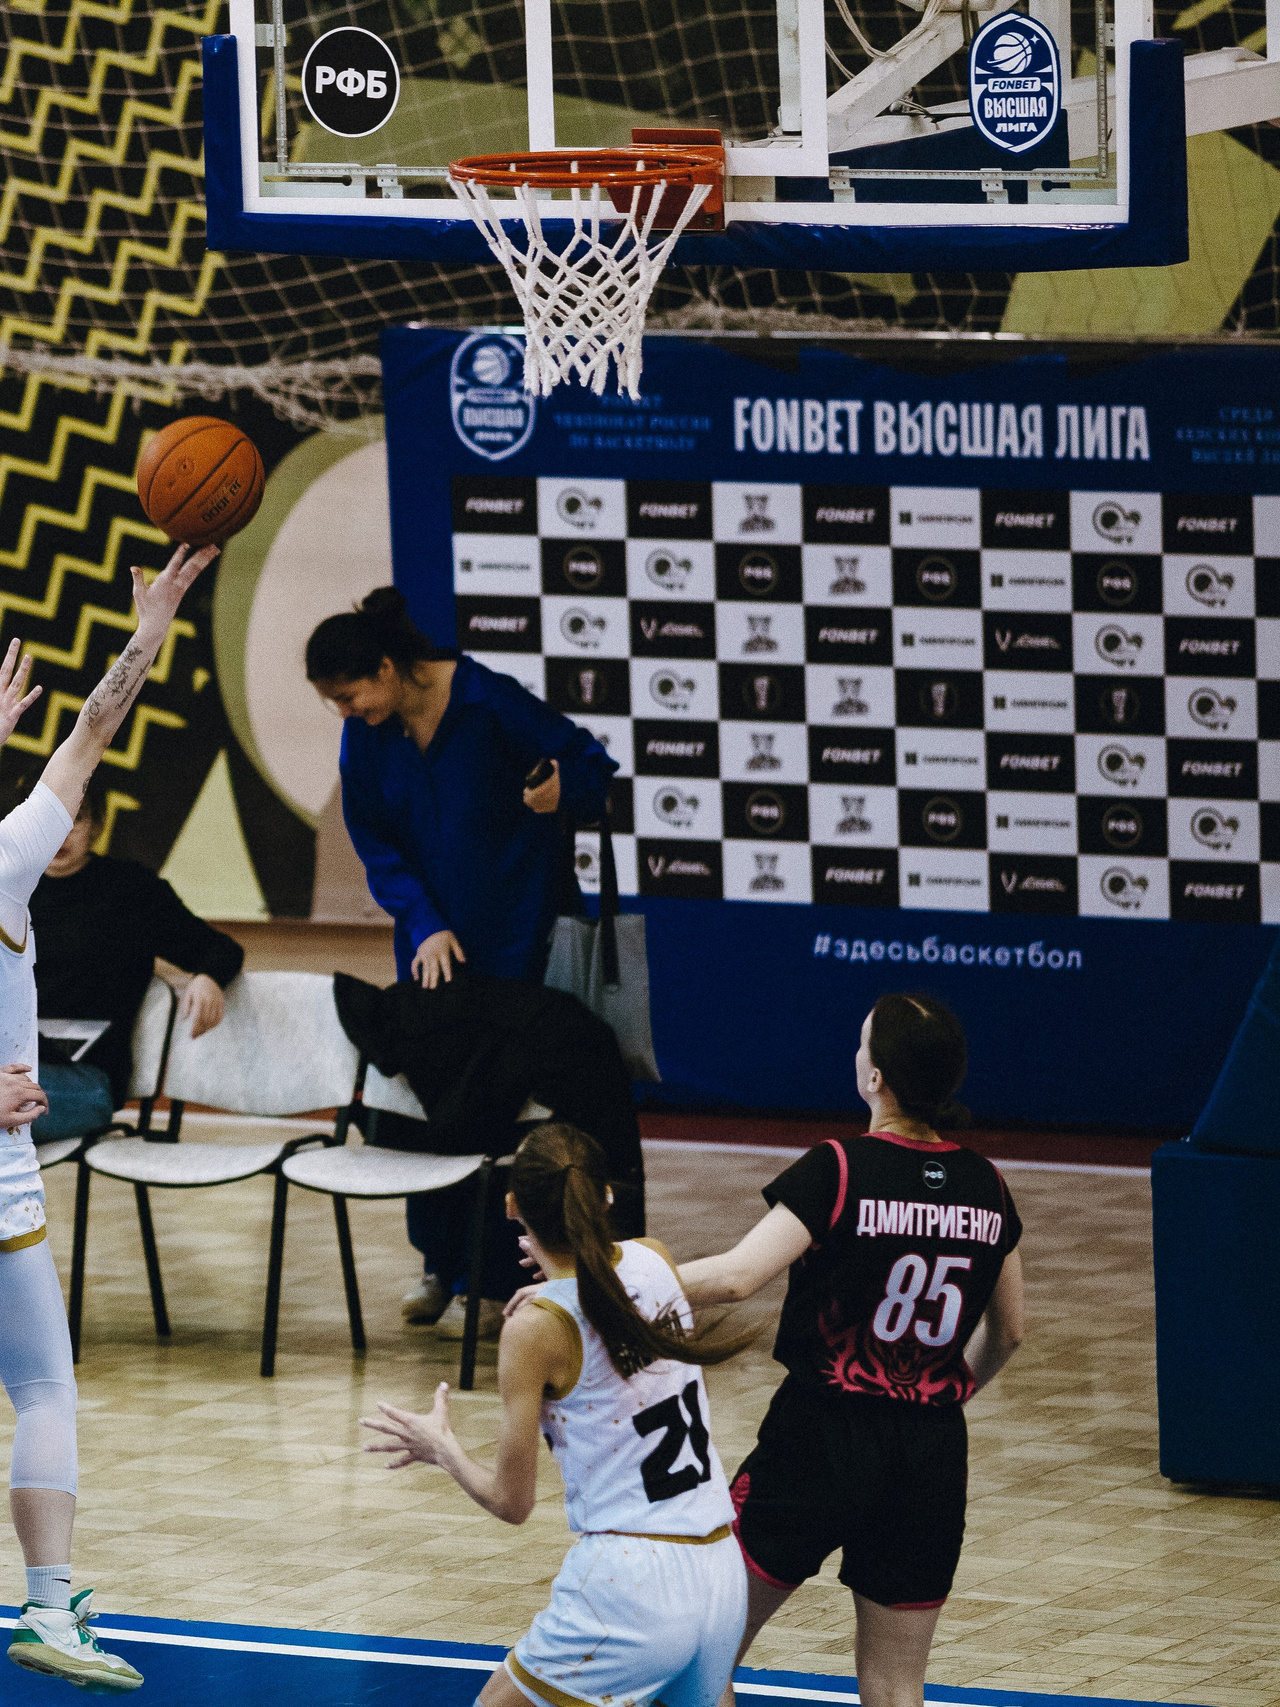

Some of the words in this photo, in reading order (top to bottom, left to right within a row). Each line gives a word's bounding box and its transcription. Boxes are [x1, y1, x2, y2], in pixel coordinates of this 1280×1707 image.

[315, 65, 387, 98] РФБ
[992, 80, 1037, 90] FONBET
[984, 97, 1047, 118] ВЫСШАЯ
[996, 122, 1037, 133] ЛИГА
[734, 397, 863, 454] FONBET
[873, 401, 1043, 457] ВЫСШАЯ
[1055, 404, 1150, 460] ЛИГА
[816, 507, 875, 523] FONBET
[995, 512, 1055, 528] FONBET
[1176, 517, 1238, 532] FONBET
[1179, 639, 1240, 655] FONBET
[856, 1199, 1003, 1246] ДМИТРИЕНКО
[873, 1254, 972, 1346] 85
[632, 1380, 711, 1503] 21
